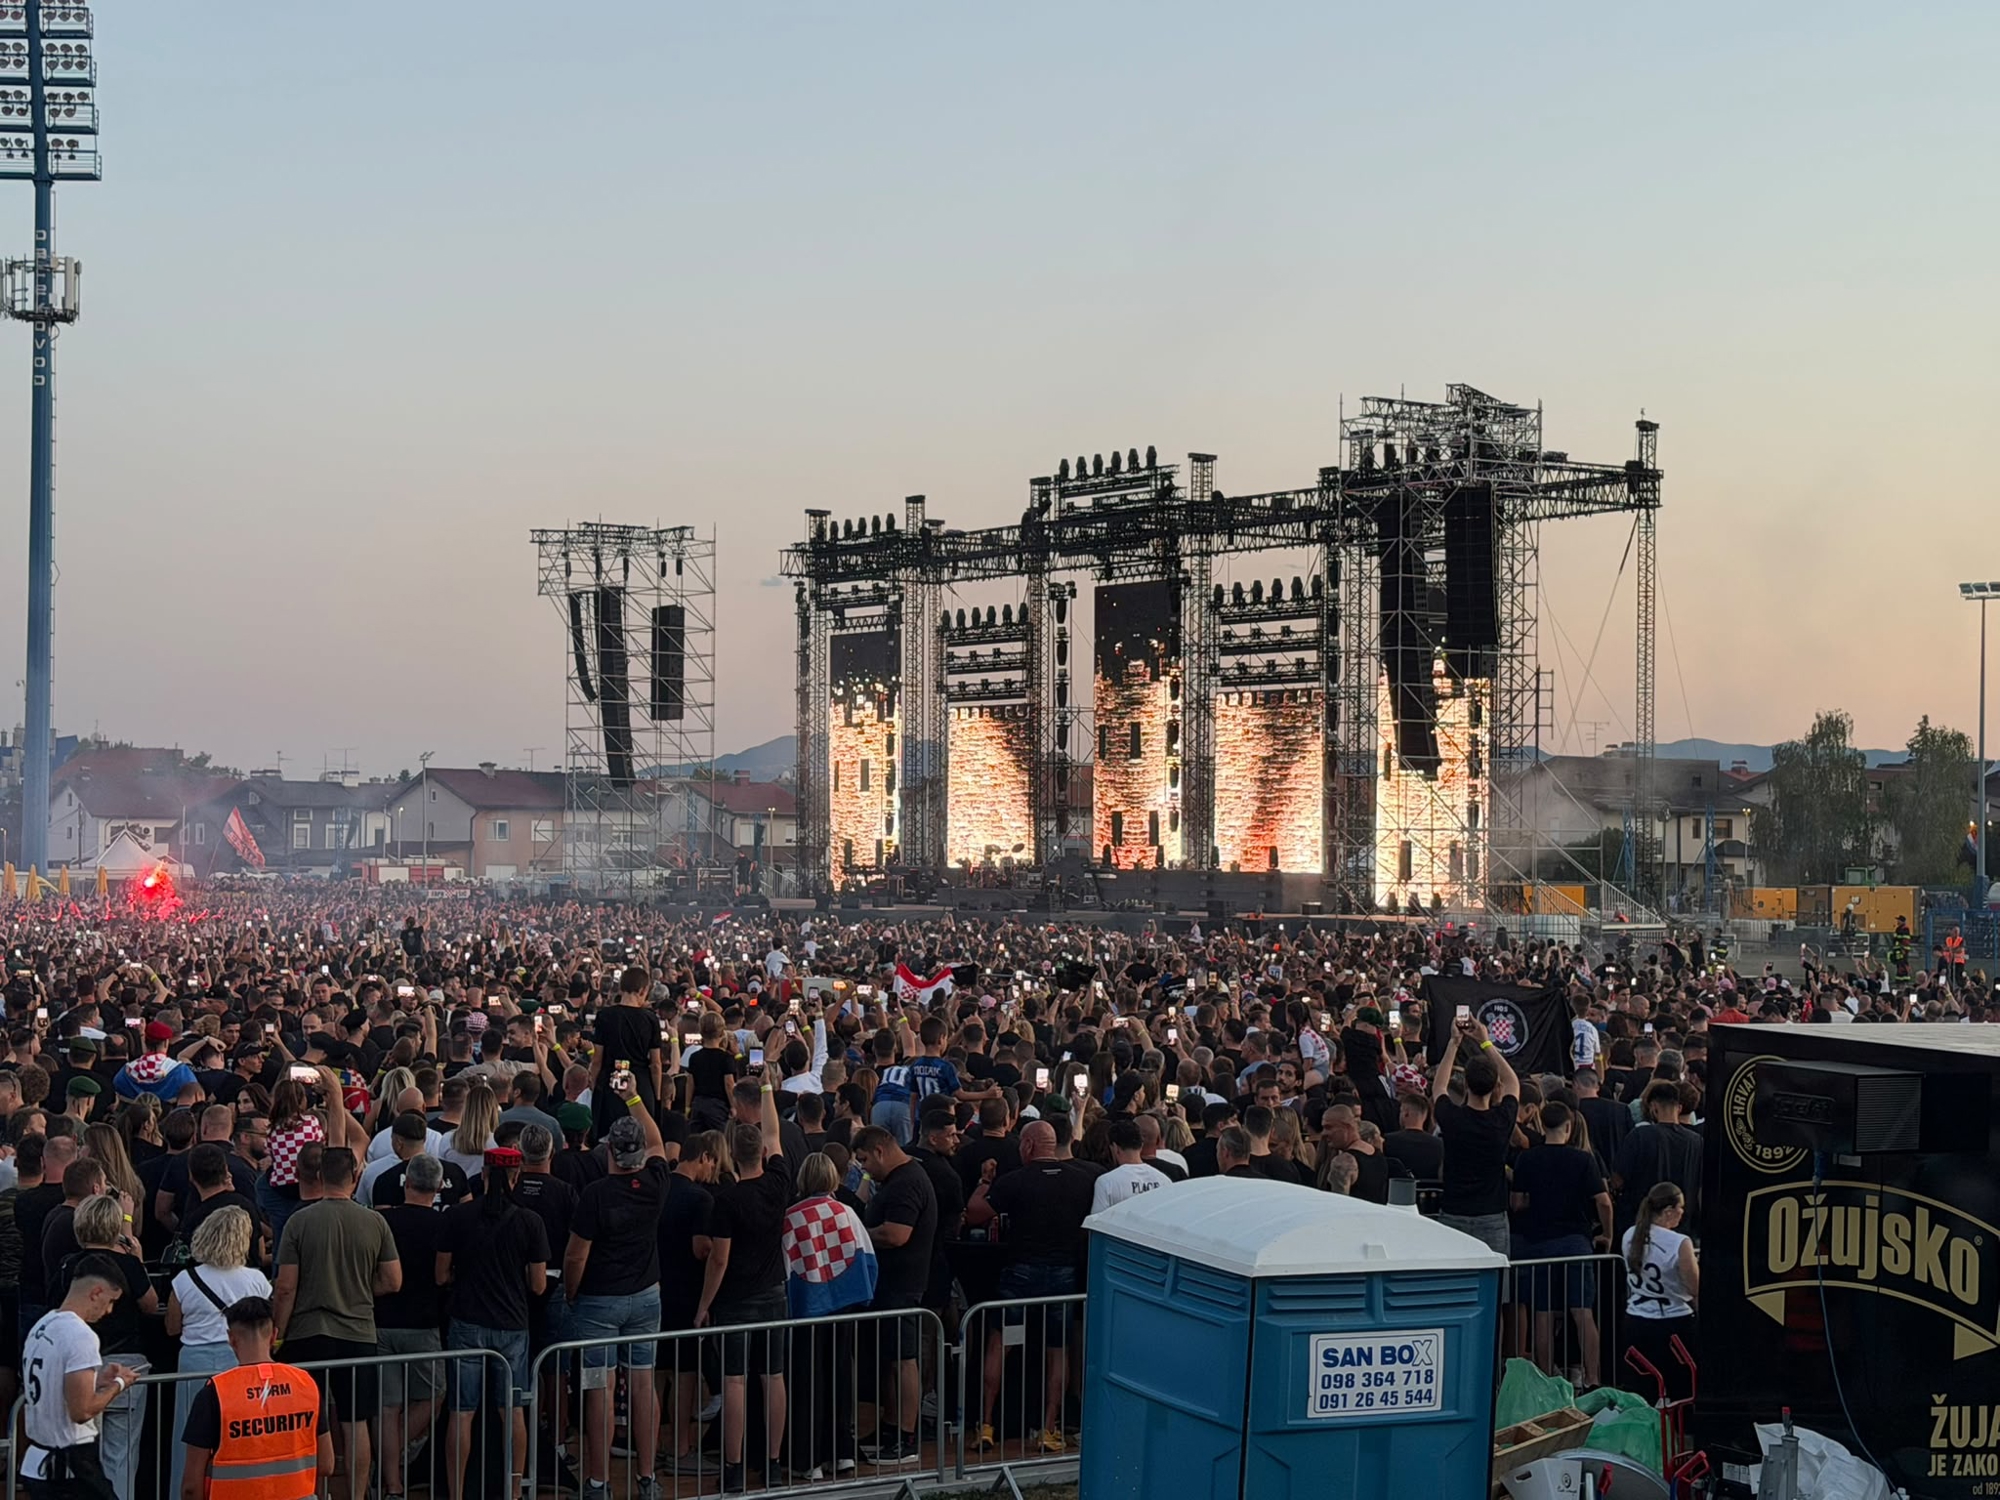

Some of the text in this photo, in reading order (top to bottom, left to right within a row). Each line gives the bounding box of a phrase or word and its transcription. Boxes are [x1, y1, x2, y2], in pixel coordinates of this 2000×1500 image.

[1322, 1340, 1433, 1368] SAN BOX
[1321, 1369, 1434, 1390] 098 364 718
[1319, 1389, 1433, 1410] 091 26 45 544
[229, 1411, 314, 1439] SECURITY
[1927, 1454, 1947, 1476] JE
[1972, 1482, 1983, 1495] od
